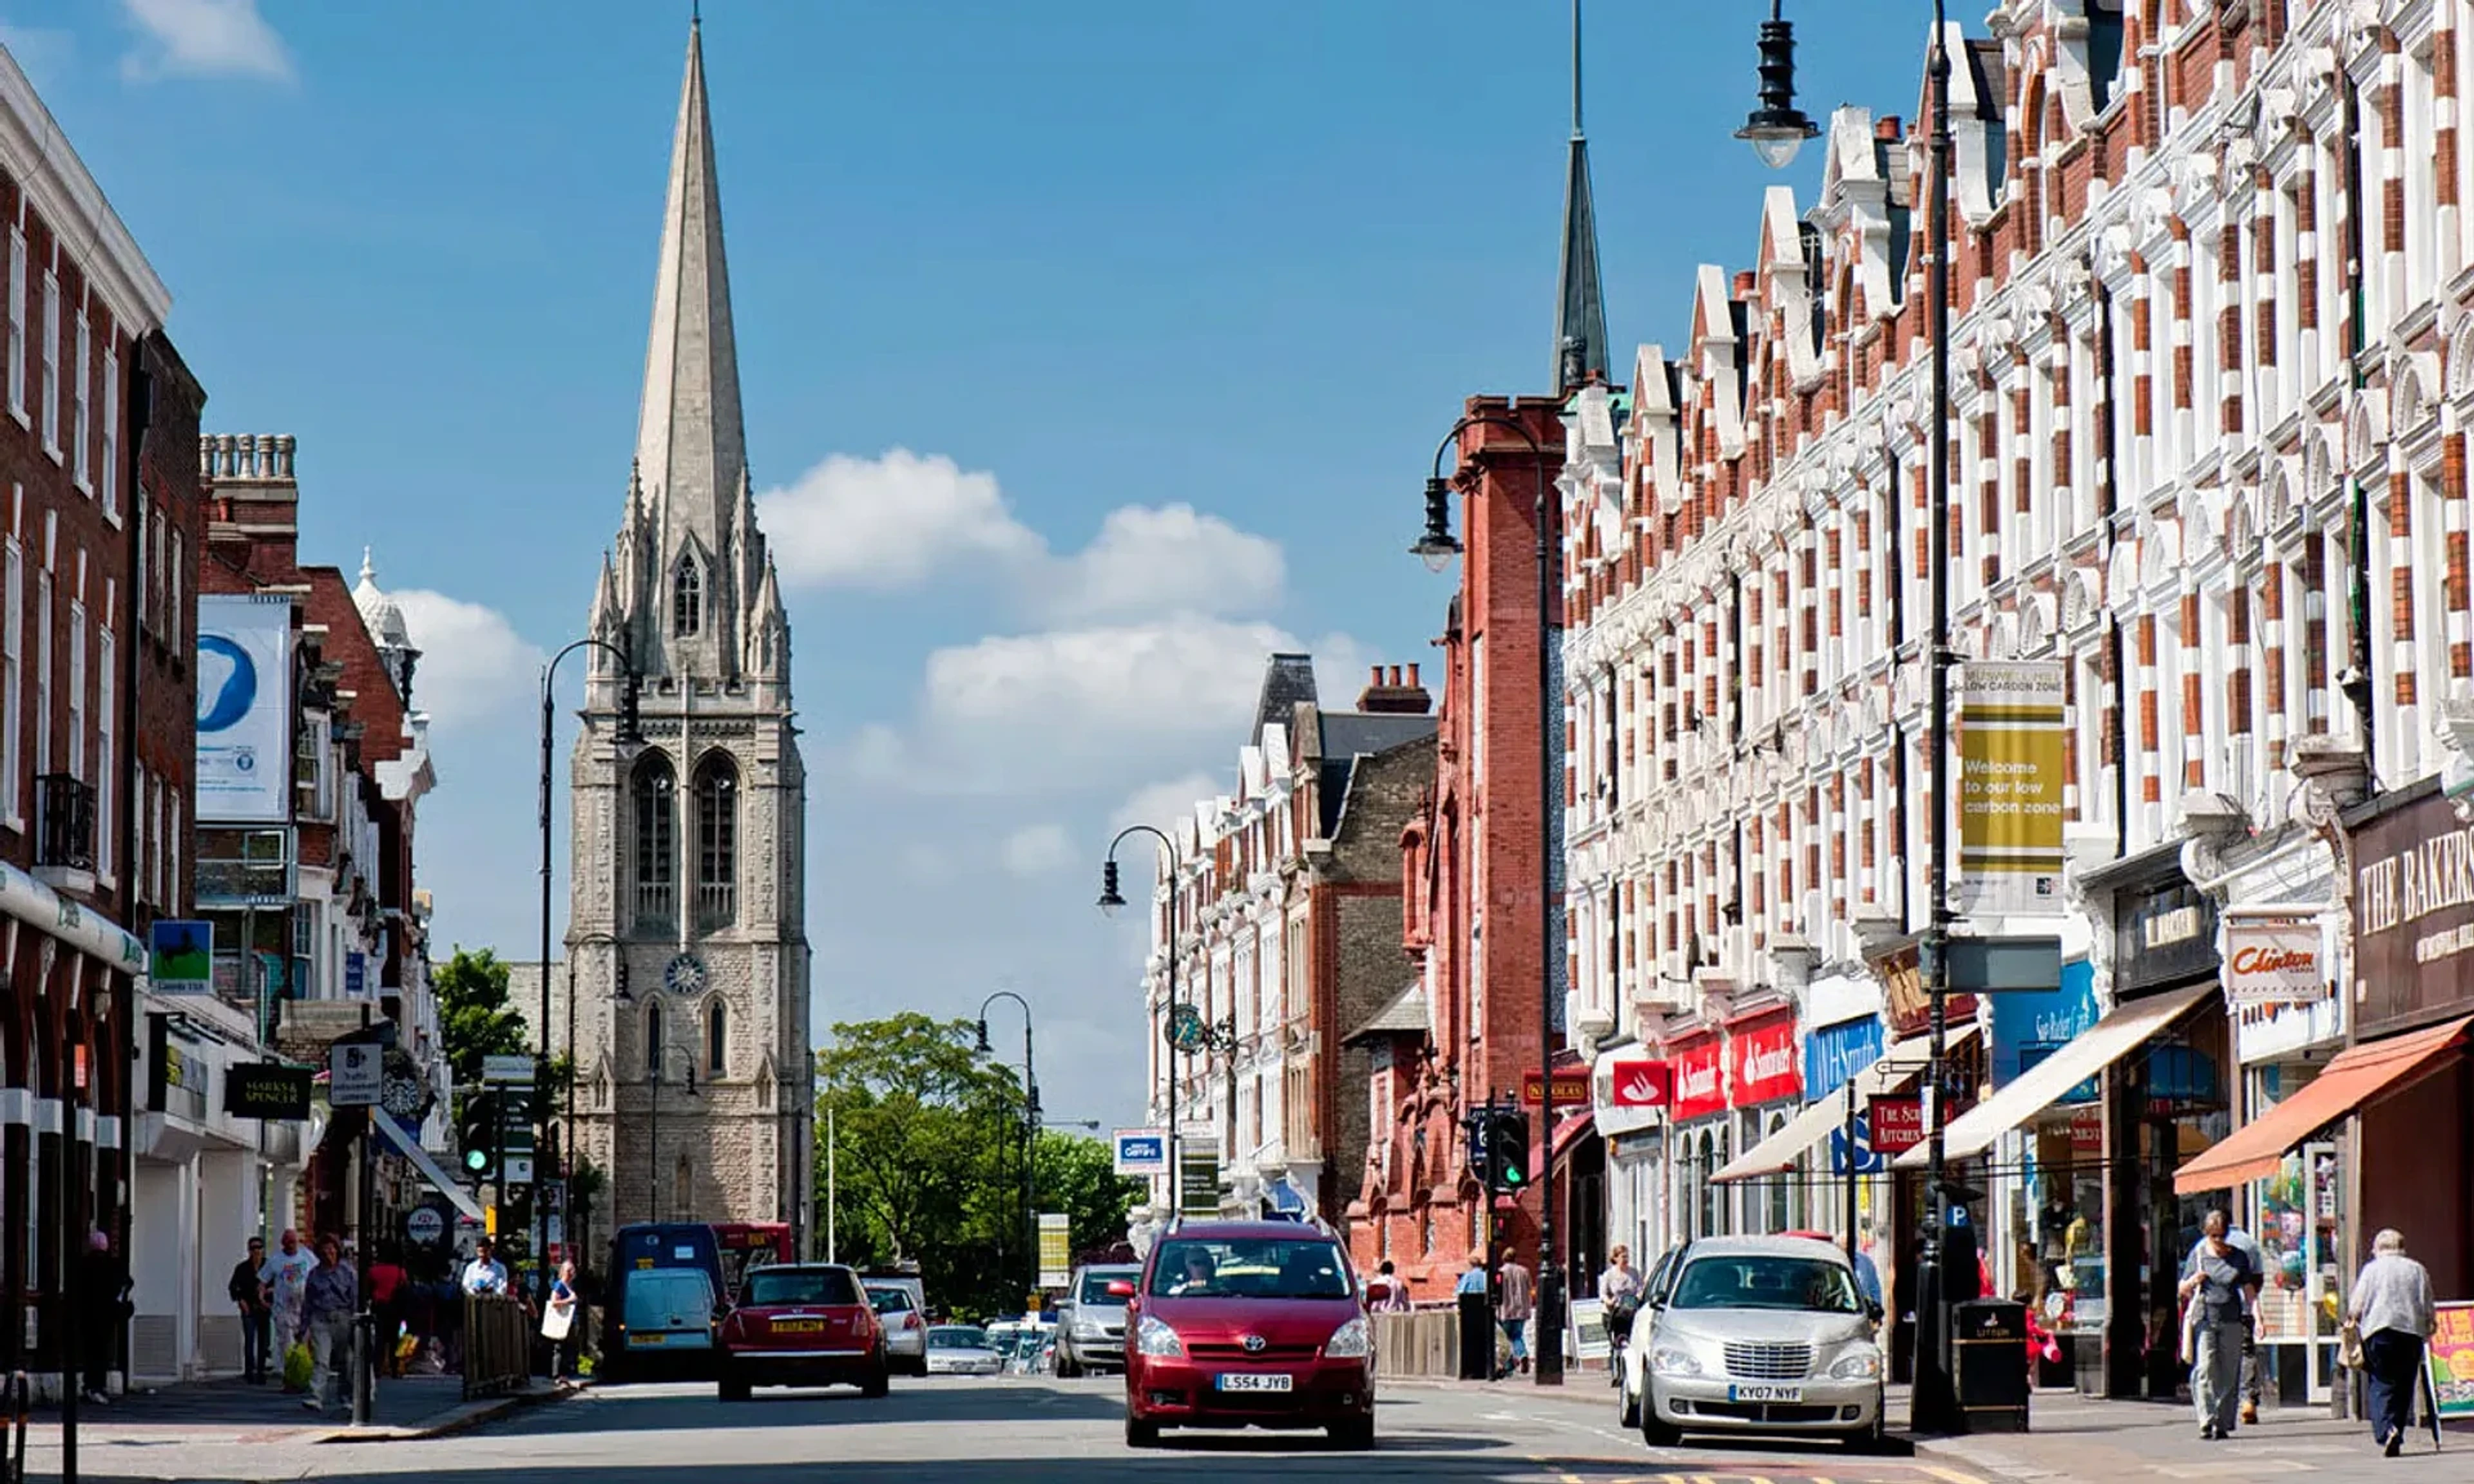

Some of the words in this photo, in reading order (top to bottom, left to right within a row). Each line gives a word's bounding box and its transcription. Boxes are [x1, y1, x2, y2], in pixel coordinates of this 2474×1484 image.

[1965, 681, 1986, 691] LOW
[1966, 760, 2037, 774] Welcome
[1966, 780, 1980, 794] to
[1985, 783, 2009, 794] our
[2015, 780, 2043, 794] low
[1966, 801, 2018, 814] carbon
[2024, 803, 2060, 814] zone
[2361, 855, 2398, 936] THE
[2232, 946, 2314, 975] Clinton
[1529, 1085, 1583, 1096] NOLAS
[1953, 1206, 1966, 1226] P
[1224, 1376, 1260, 1388] LS54
[1740, 1387, 1772, 1398] KY07
